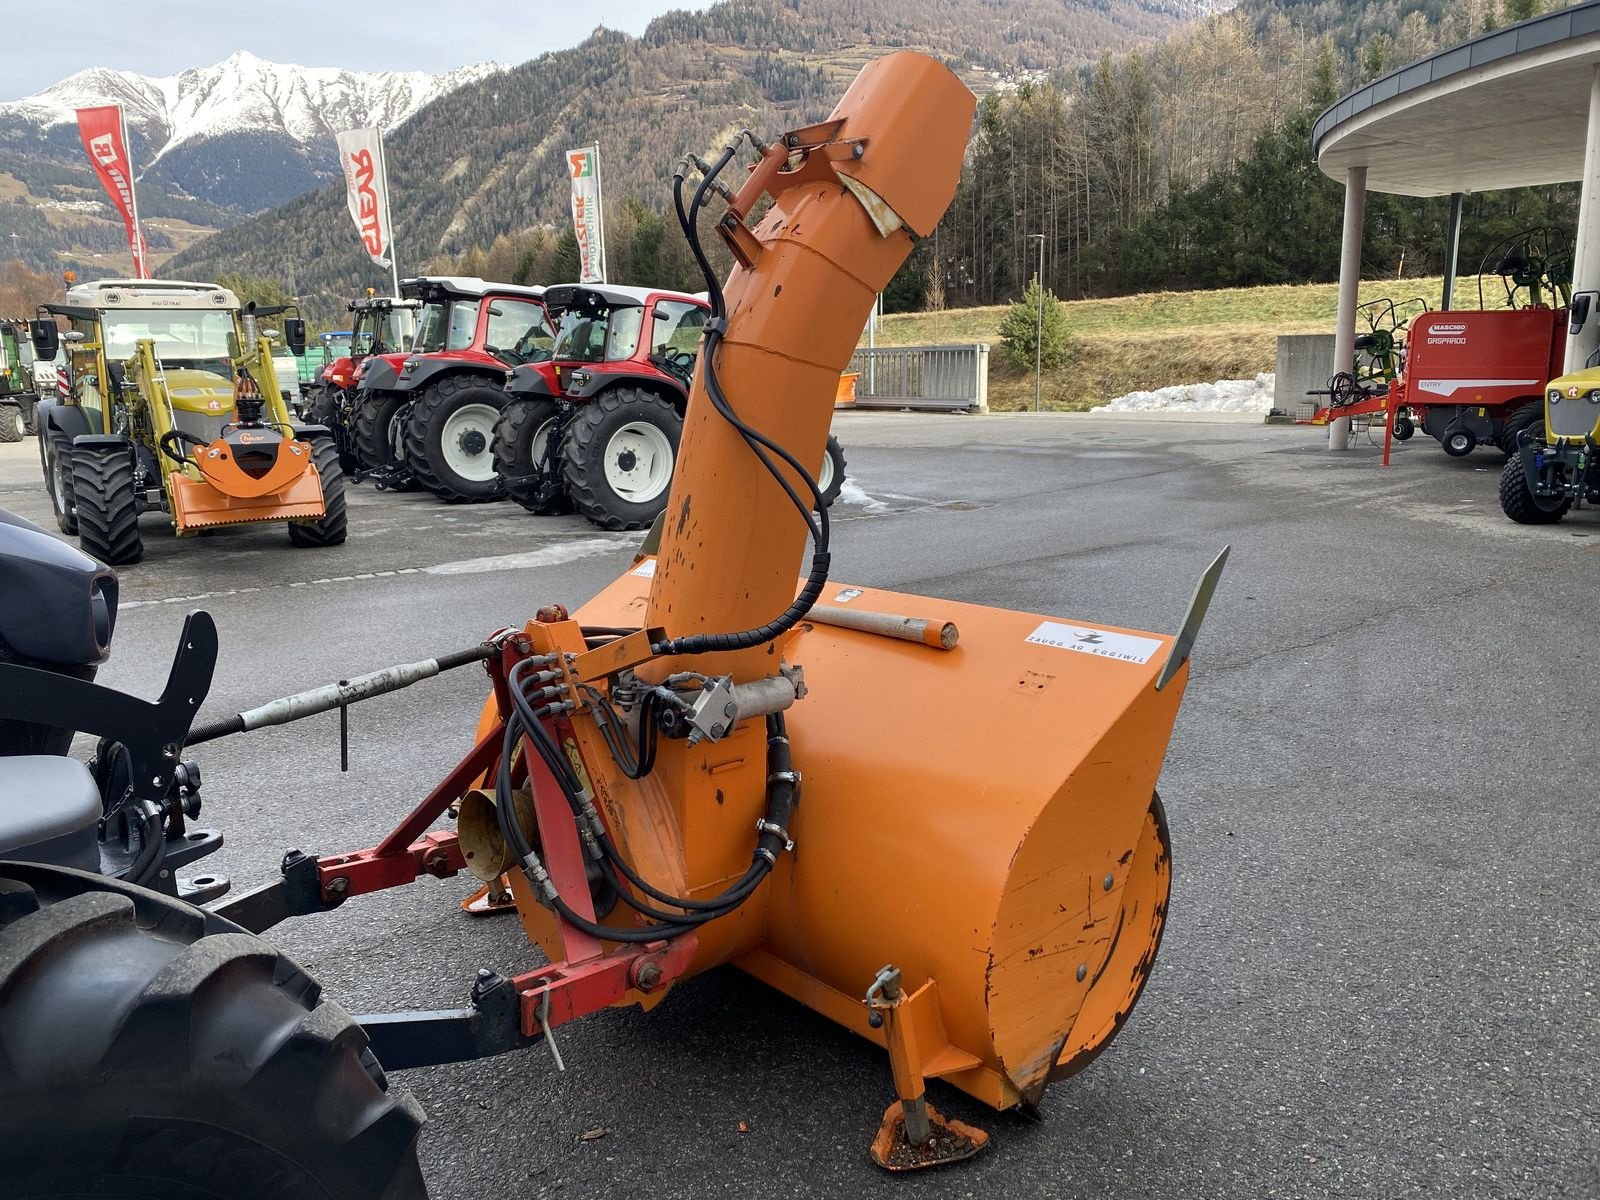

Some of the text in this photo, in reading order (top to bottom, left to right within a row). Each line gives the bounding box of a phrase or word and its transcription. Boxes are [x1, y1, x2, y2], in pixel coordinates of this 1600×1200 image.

[1028, 636, 1145, 663] ZAUGG AG EGGIWIL
